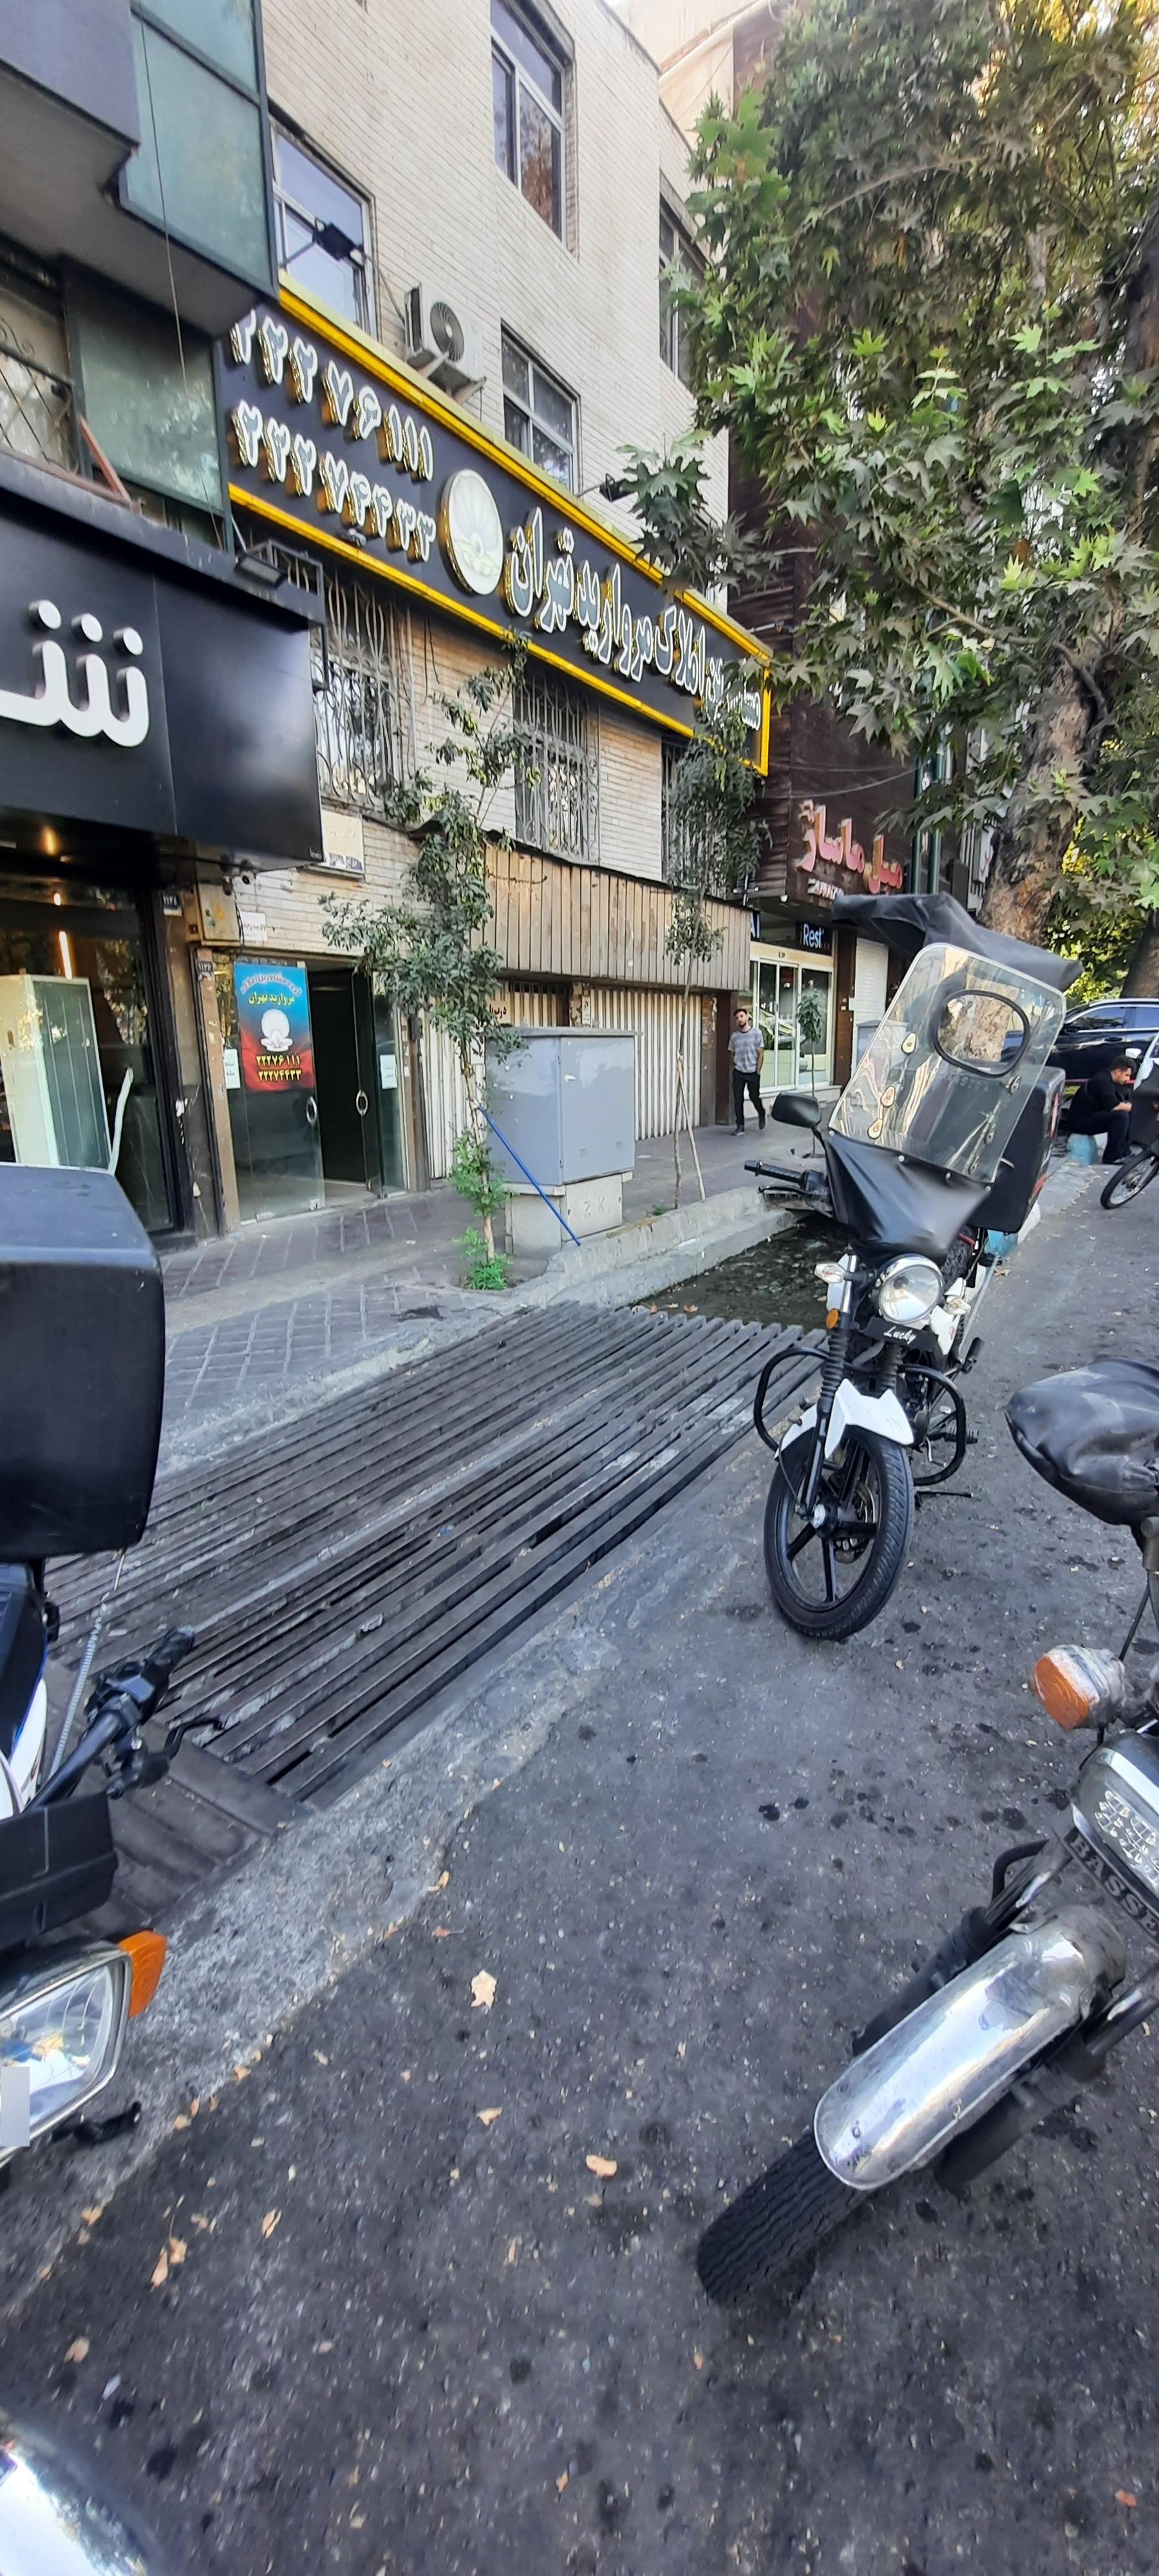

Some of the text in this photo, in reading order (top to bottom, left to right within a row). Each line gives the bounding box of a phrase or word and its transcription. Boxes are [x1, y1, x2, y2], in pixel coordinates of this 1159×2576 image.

[509, 506, 574, 634] تهران
[578, 560, 654, 683] مروارید
[654, 604, 706, 697] املاک
[248, 990, 296, 1005] مروارید تهران
[256, 1054, 300, 1067] ۲۲۲۷۶۱۱۱
[258, 1068, 302, 1083] ۲۲۲۷۴۴۳۳
[883, 1325, 917, 1345] Lucky
